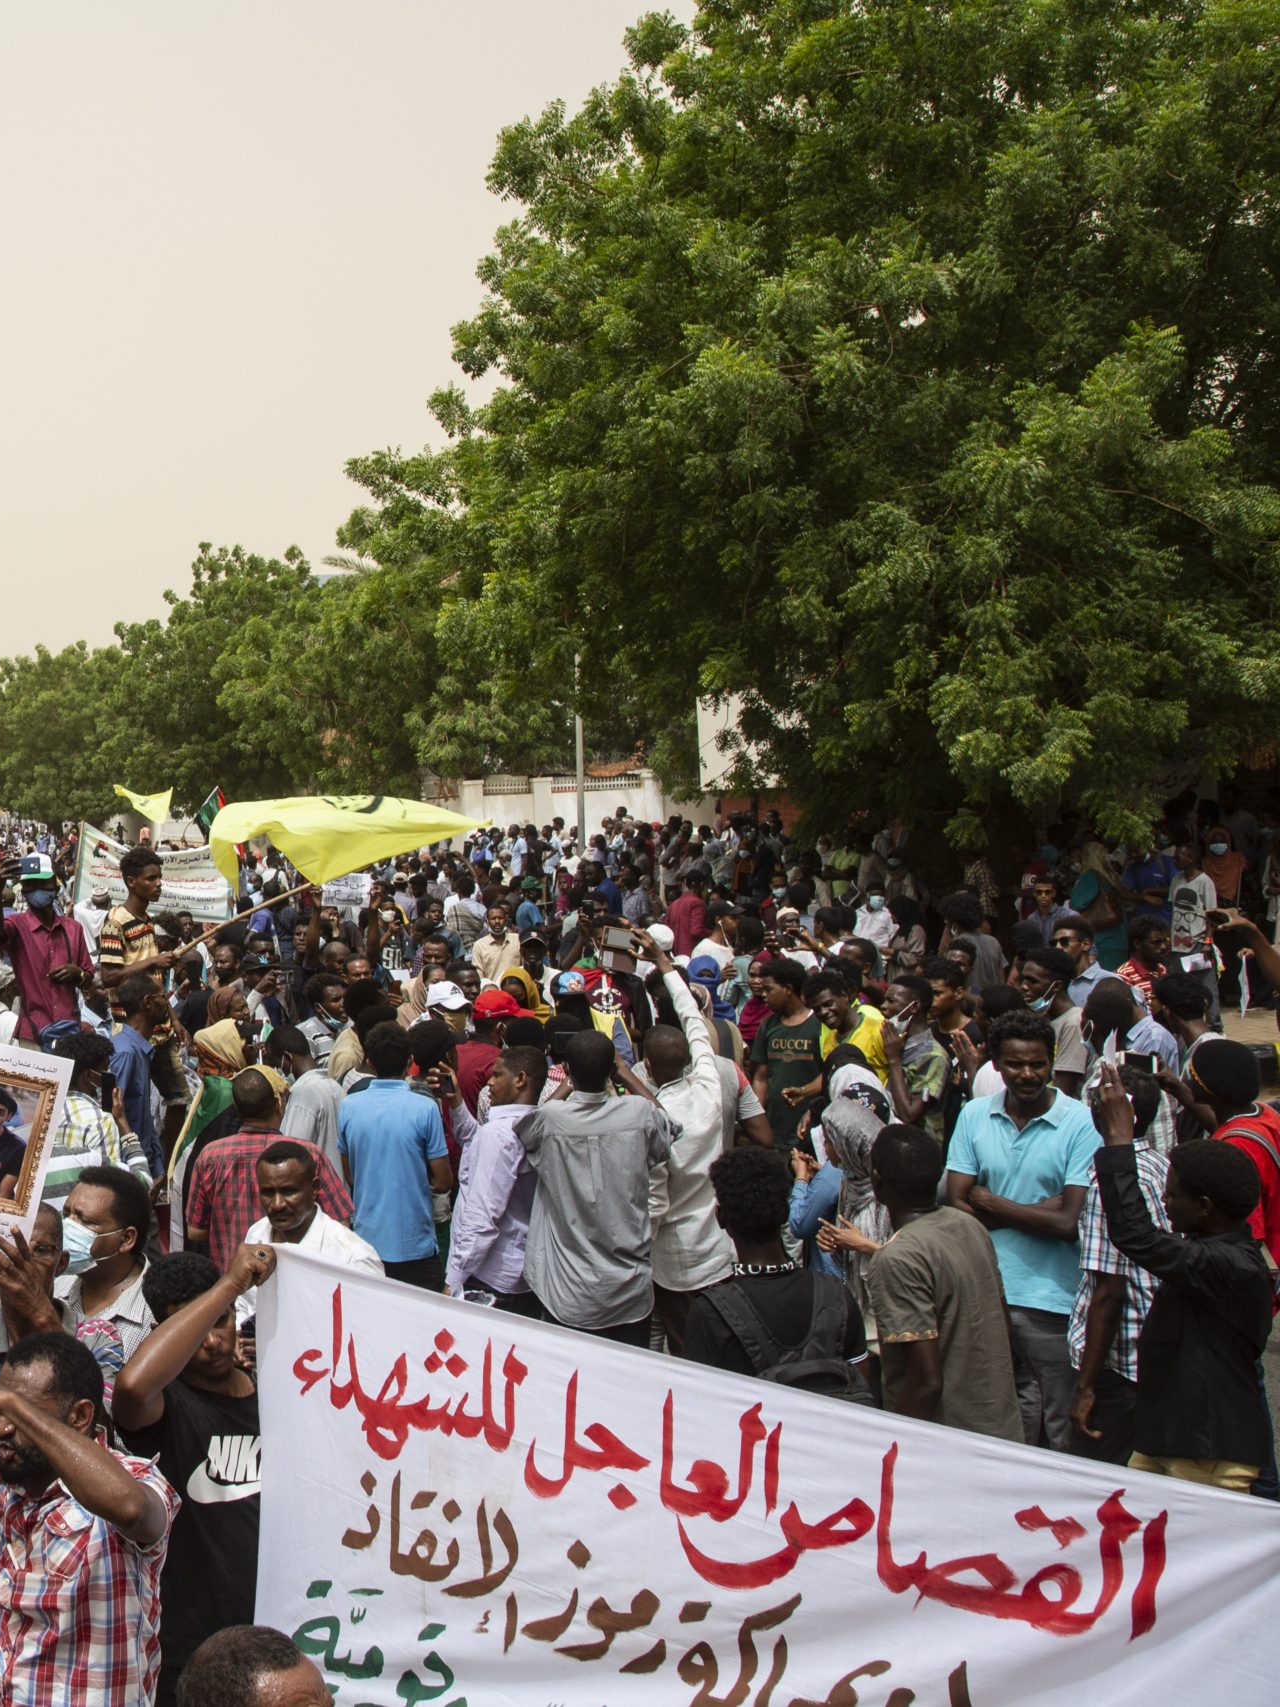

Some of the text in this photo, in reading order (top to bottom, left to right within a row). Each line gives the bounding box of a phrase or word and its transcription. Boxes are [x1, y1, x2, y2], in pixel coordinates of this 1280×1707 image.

[771, 1039, 809, 1051] GUCCI
[207, 1435, 262, 1482] NIK
[292, 1282, 1168, 1643] القصاص العاجل للشهداء
